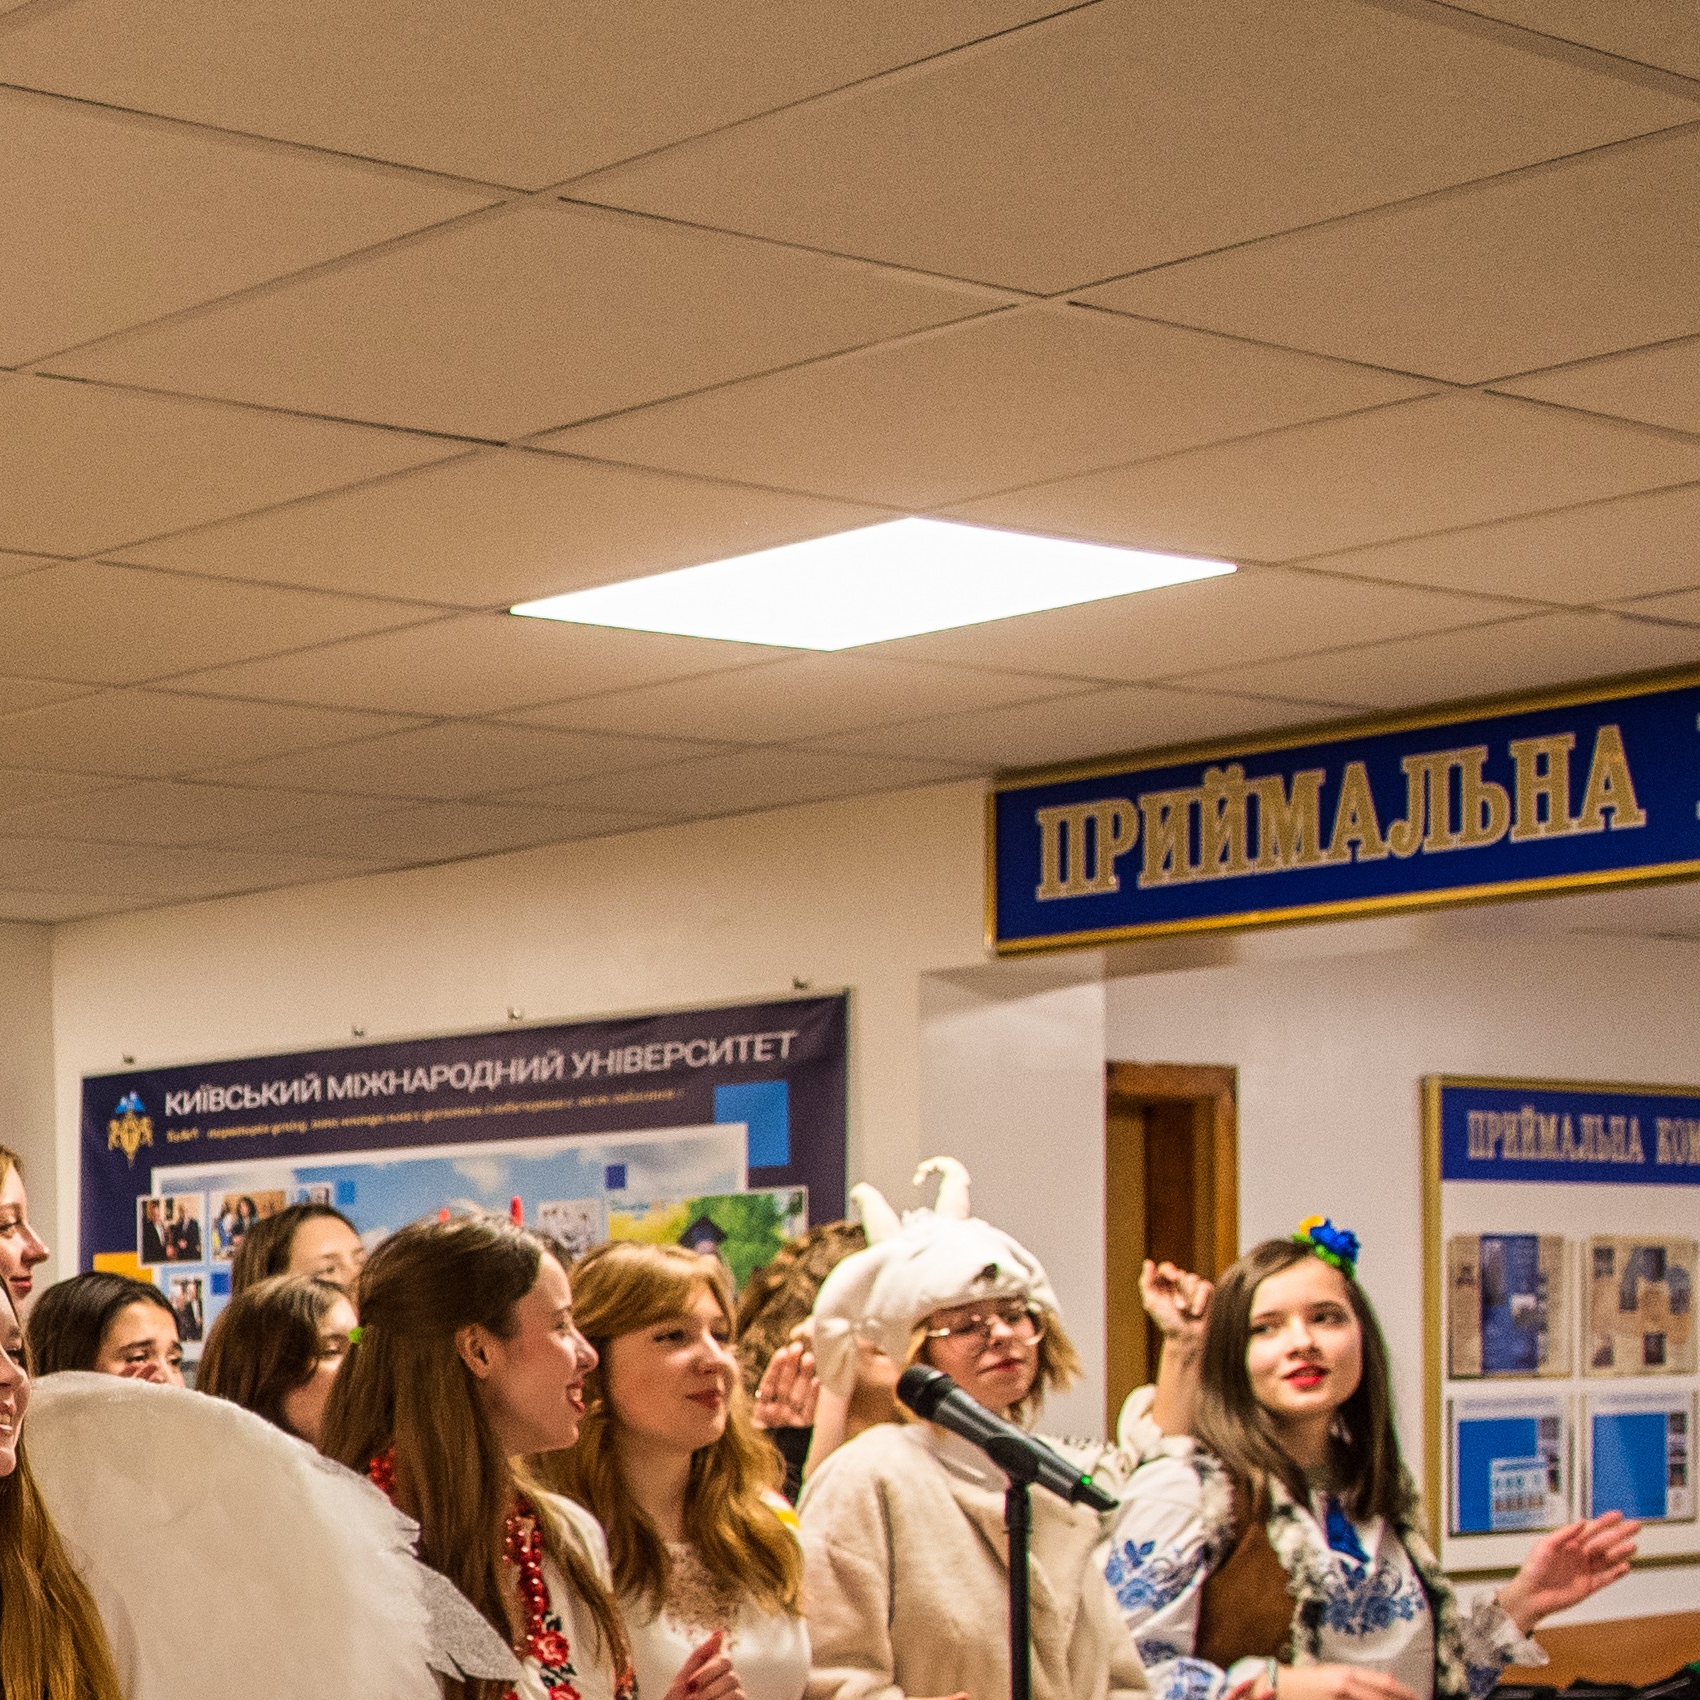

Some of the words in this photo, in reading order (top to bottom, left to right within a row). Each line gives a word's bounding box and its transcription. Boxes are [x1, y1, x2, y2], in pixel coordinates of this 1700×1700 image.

[1036, 724, 1647, 901] ПРИЙМАЛЬНА
[164, 1072, 322, 1117] КИЇВСЬКИЙ
[327, 1050, 565, 1101] МІЖНАРОДНИЙ
[571, 1029, 798, 1079] УНІВЕРСИТЕТ
[1467, 1105, 1645, 1164] ПРИЙМАЛЬНА
